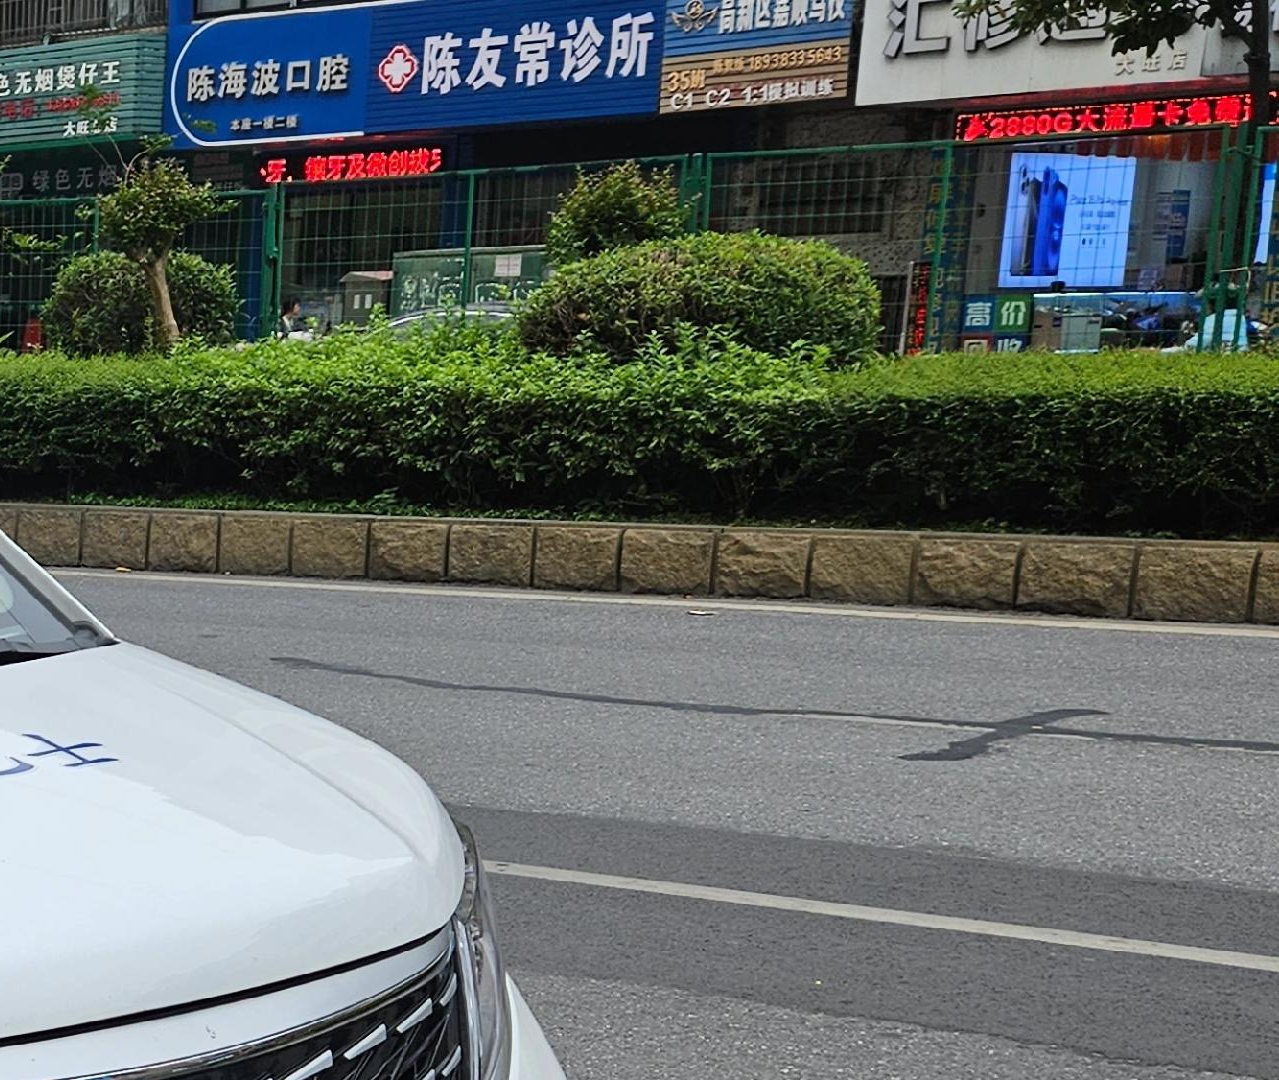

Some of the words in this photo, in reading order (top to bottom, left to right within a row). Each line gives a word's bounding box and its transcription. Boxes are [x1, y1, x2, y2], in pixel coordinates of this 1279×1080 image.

[421, 12, 655, 96] 陈友常诊所
[187, 54, 350, 102] 陈海波口腔
[670, 92, 693, 110] C1
[705, 88, 731, 107] C2
[965, 301, 1027, 326] 高价
